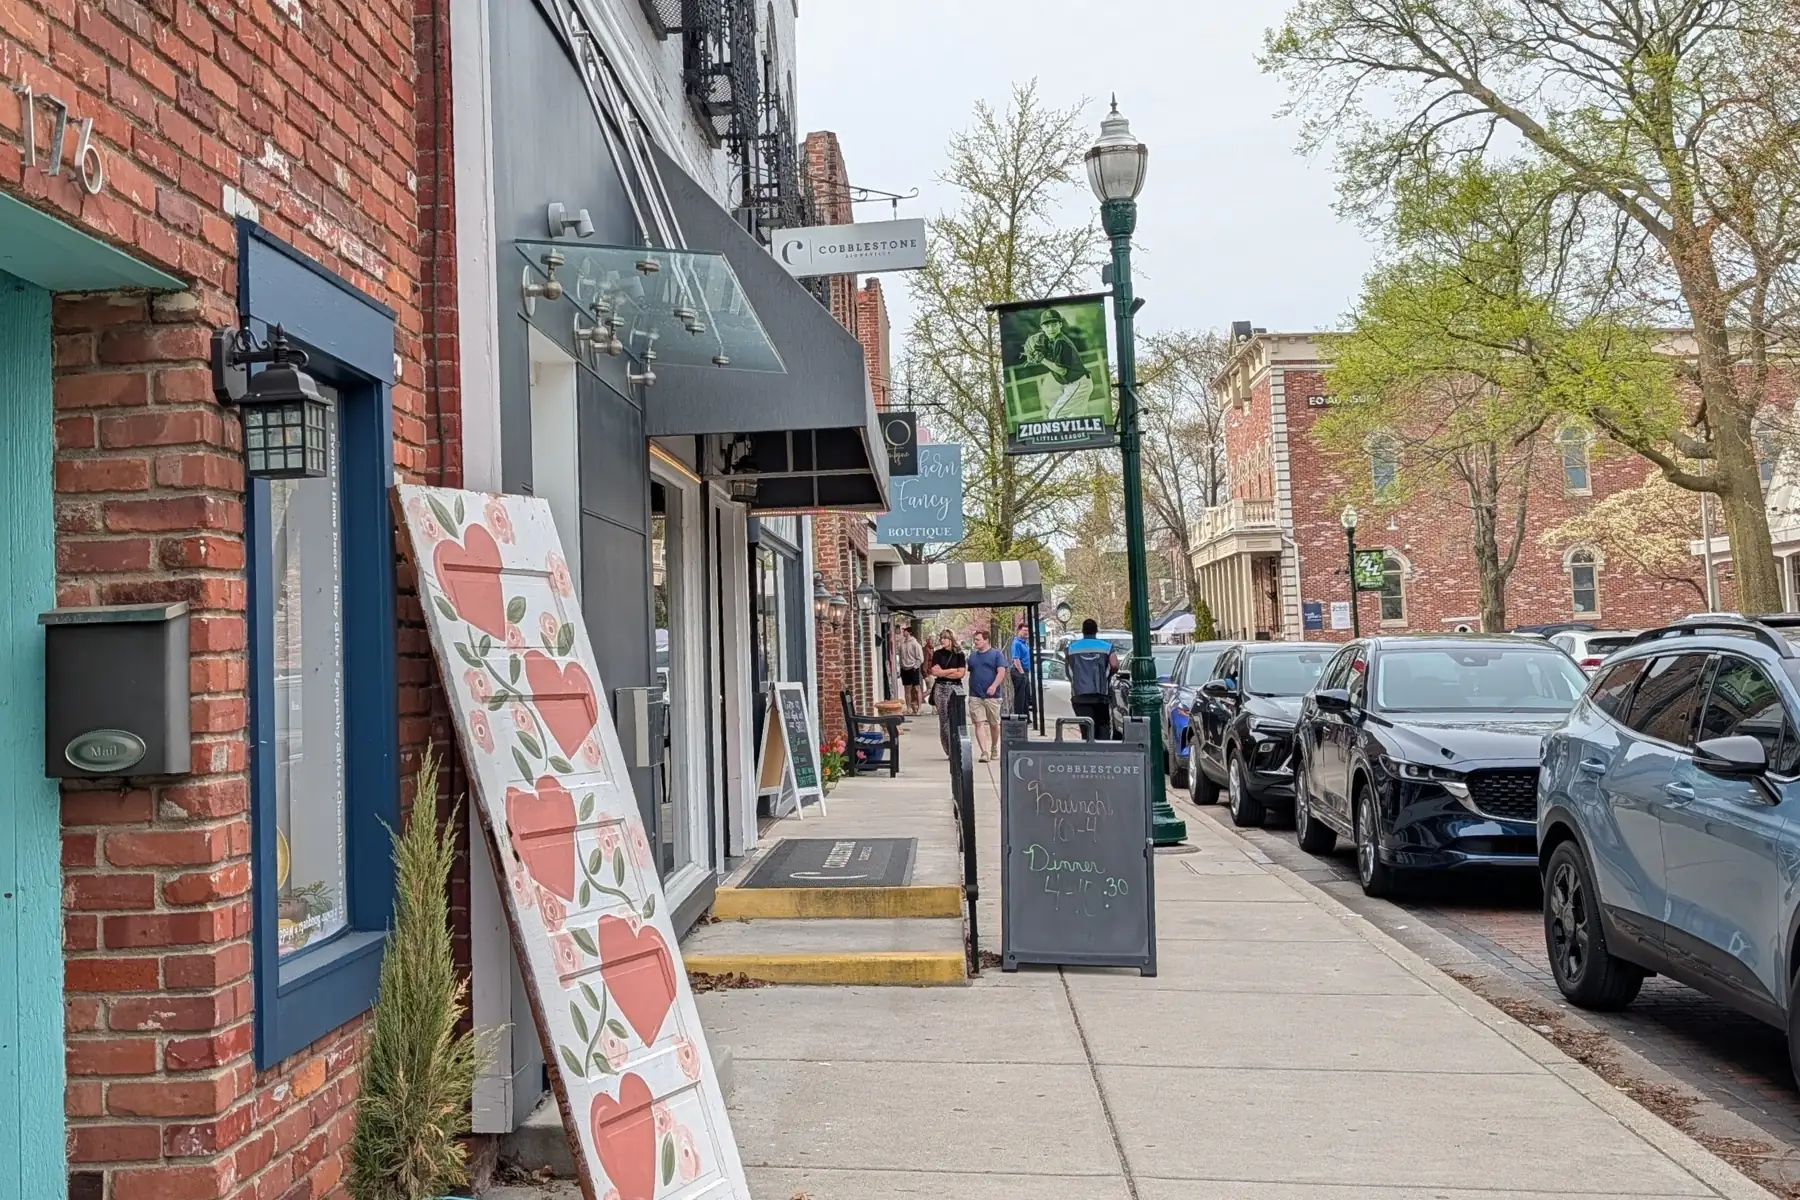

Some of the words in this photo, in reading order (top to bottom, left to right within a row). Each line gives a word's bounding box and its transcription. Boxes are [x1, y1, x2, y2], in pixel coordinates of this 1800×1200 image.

[12, 85, 103, 195] 176
[819, 239, 917, 255] COBBLESTONE
[1019, 418, 1103, 438] ZIONSVILLE
[1060, 432, 1086, 441] LEAGUE
[895, 479, 952, 521] Fancy
[888, 527, 952, 540] BOUTIQUE
[332, 585, 340, 618] Baby
[91, 745, 117, 758] Mail
[1047, 764, 1140, 775] COBBLESTONE
[1022, 843, 1106, 875] Dinner
